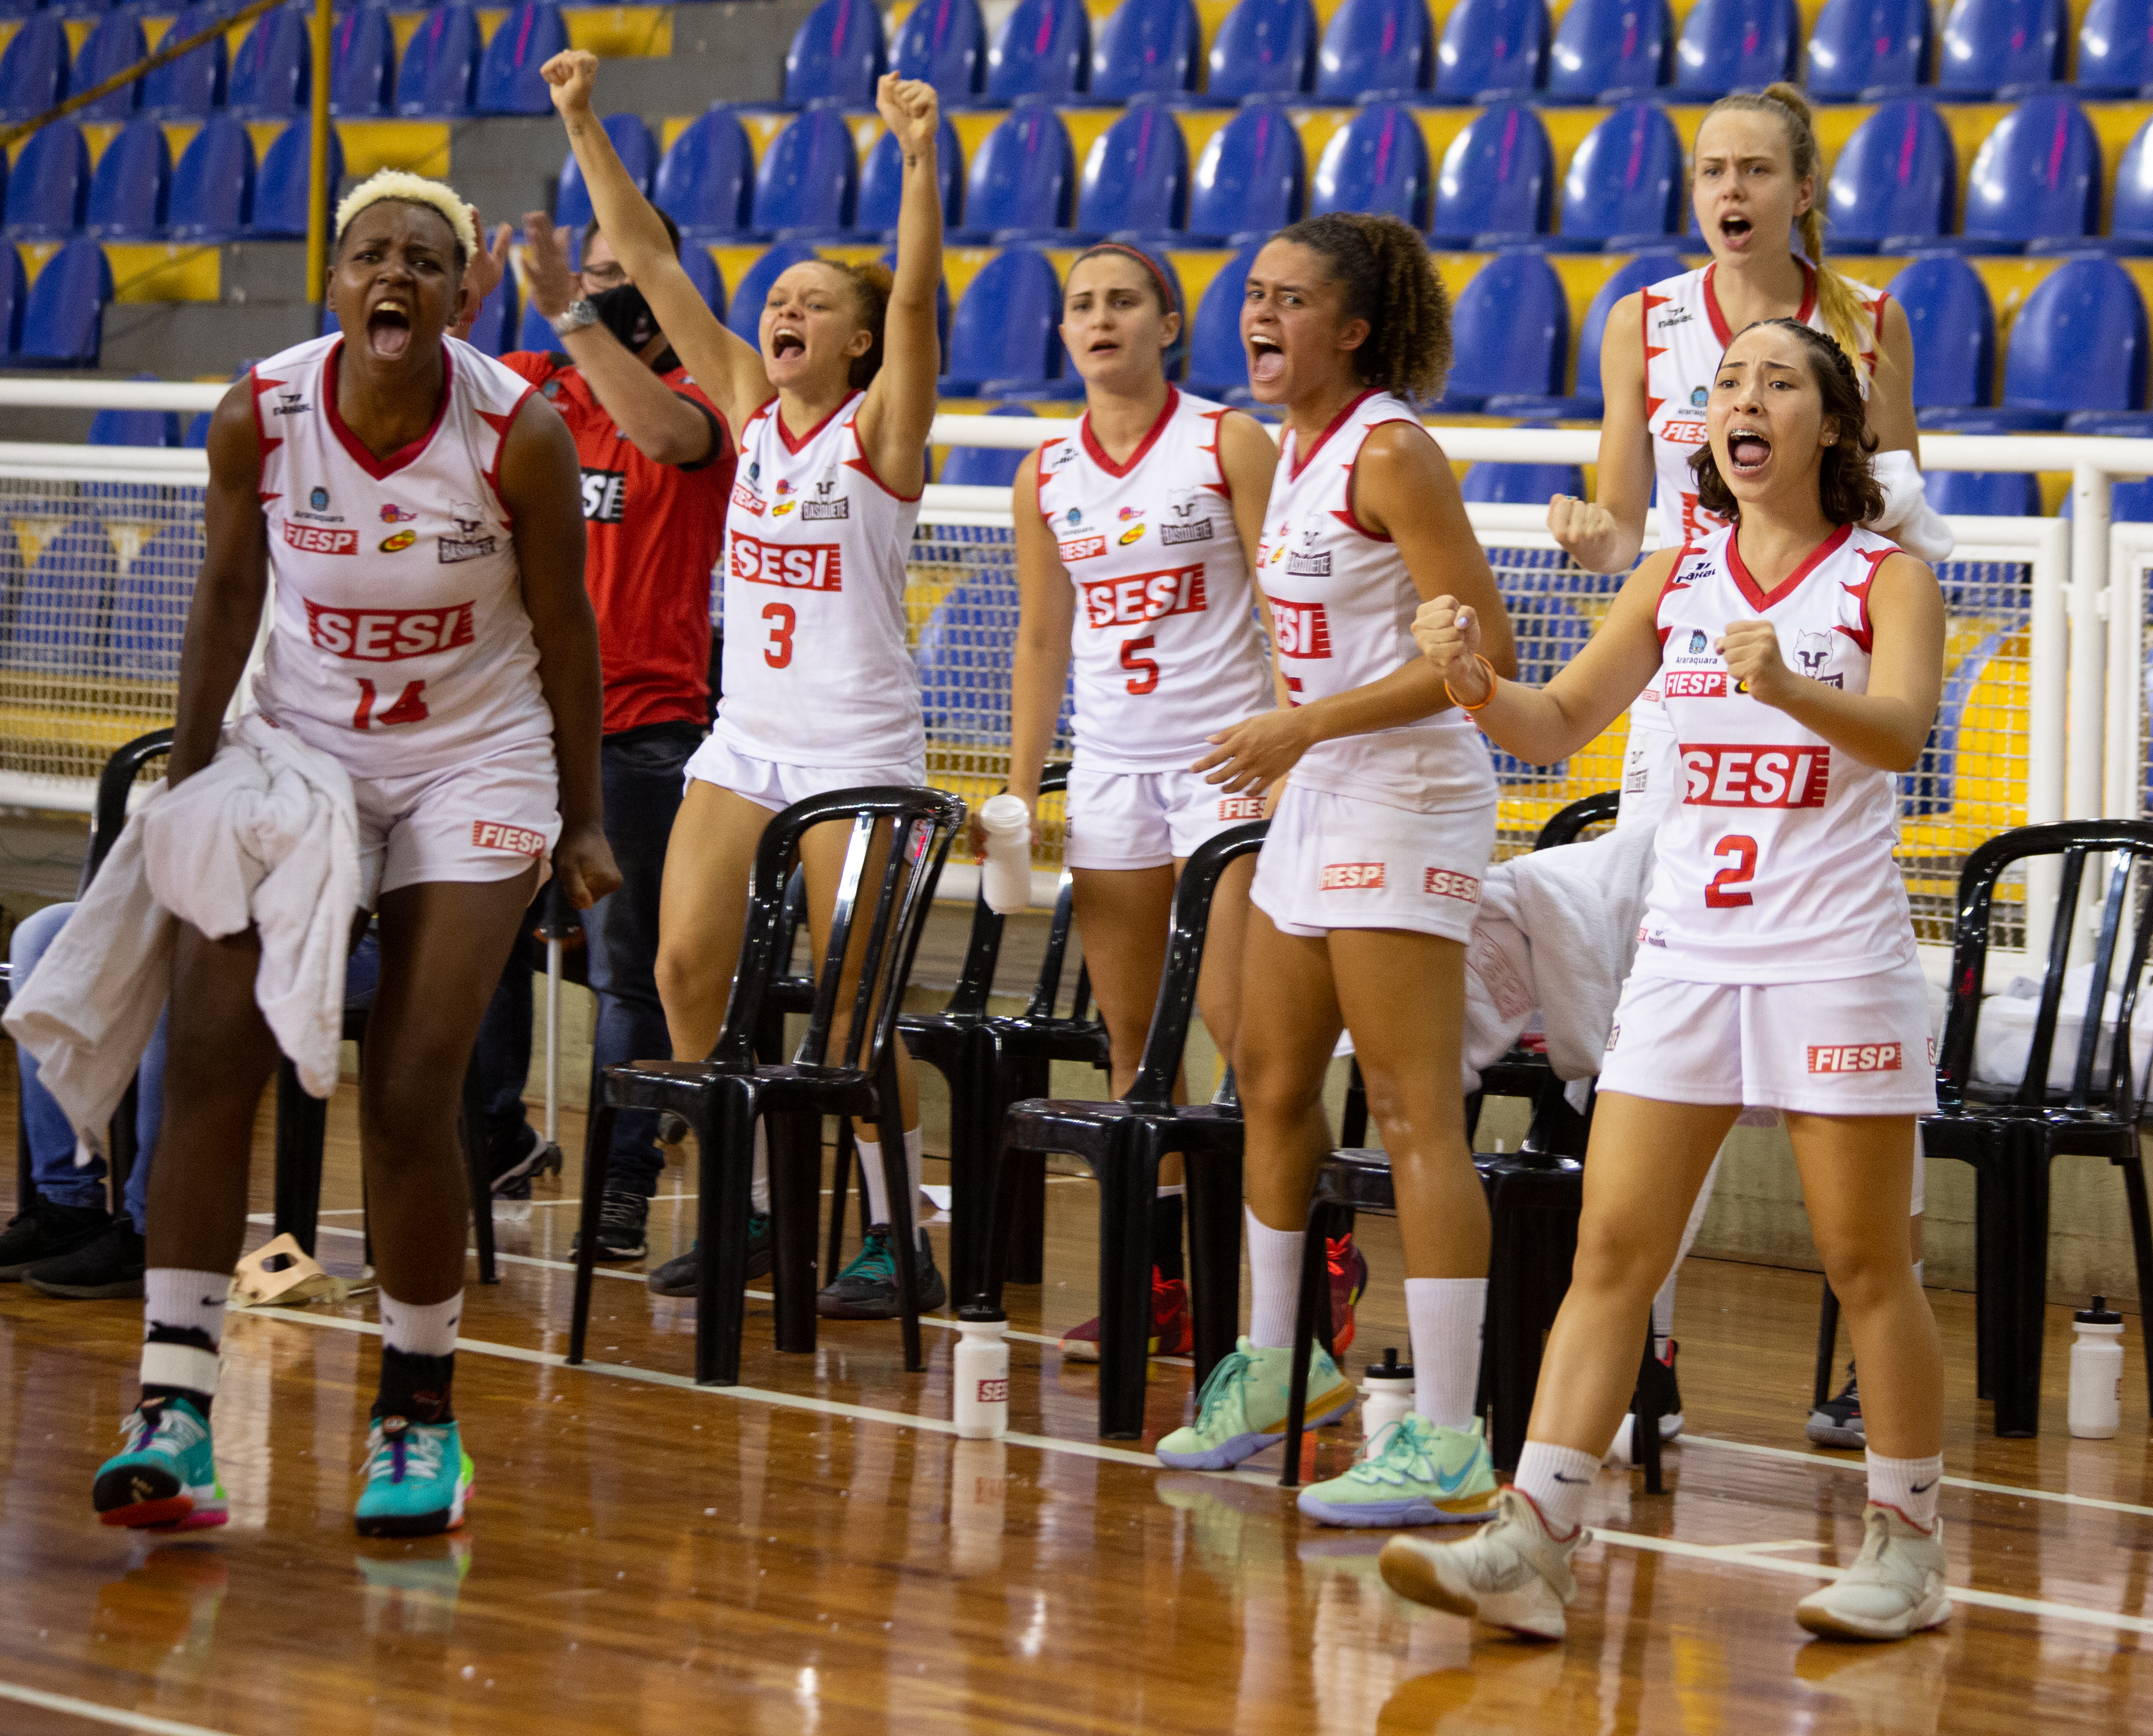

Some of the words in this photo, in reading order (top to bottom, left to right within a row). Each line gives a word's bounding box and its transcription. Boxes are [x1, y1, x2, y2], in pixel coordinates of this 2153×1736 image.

[286, 526, 353, 552] FIESP
[735, 539, 828, 587] SESI
[1089, 571, 1193, 625] SESI
[316, 610, 463, 657] SESI
[761, 602, 796, 669] 3
[1119, 635, 1160, 694] 5
[1666, 673, 1721, 695] FIESP
[1676, 656, 1718, 666] Araraquara
[1681, 751, 1813, 803] SESI
[478, 824, 544, 854] FIESP
[1705, 834, 1758, 908] 2
[1815, 1046, 1896, 1071] FIESP
